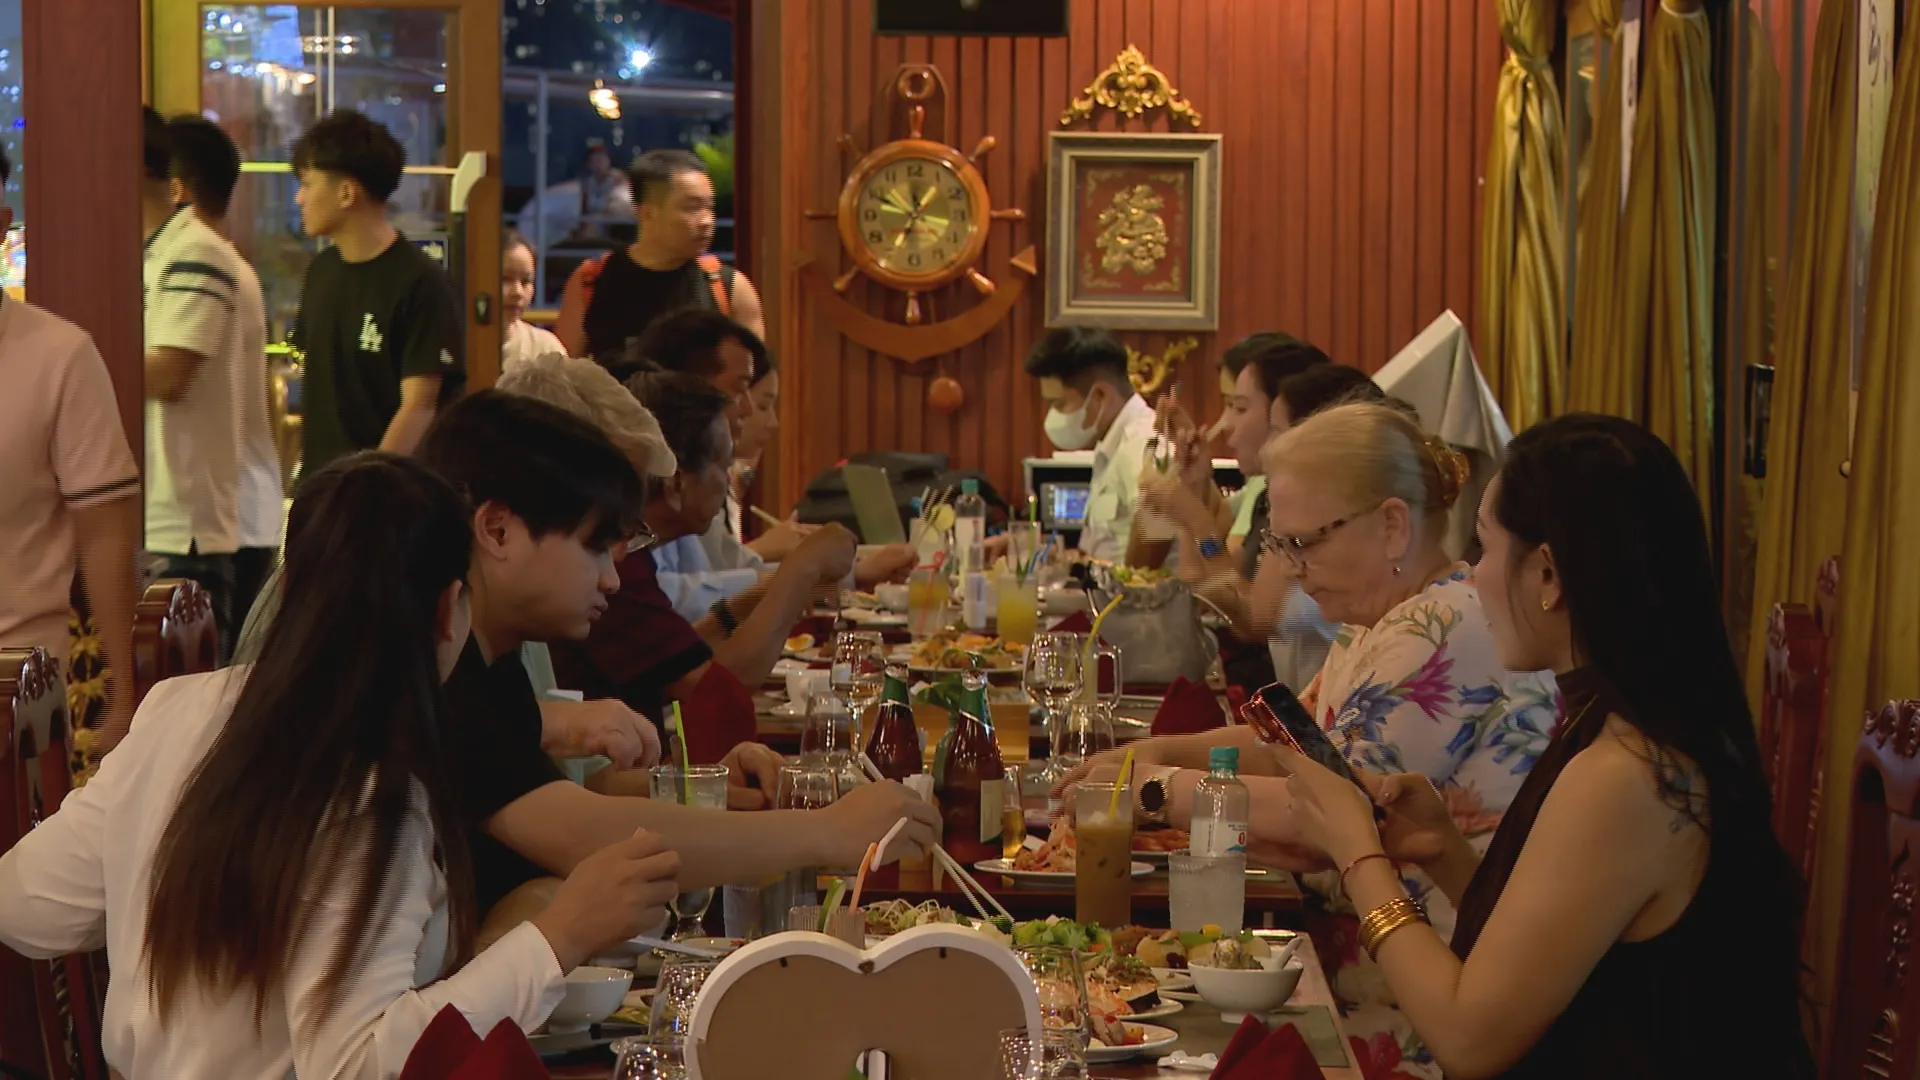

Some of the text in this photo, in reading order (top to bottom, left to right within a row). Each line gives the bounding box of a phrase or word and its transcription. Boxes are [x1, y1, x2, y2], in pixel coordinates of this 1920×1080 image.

[907, 165, 923, 177] 12
[948, 187, 963, 200] 2
[864, 209, 877, 221] 9
[869, 231, 882, 243] 8
[908, 253, 921, 267] 6
